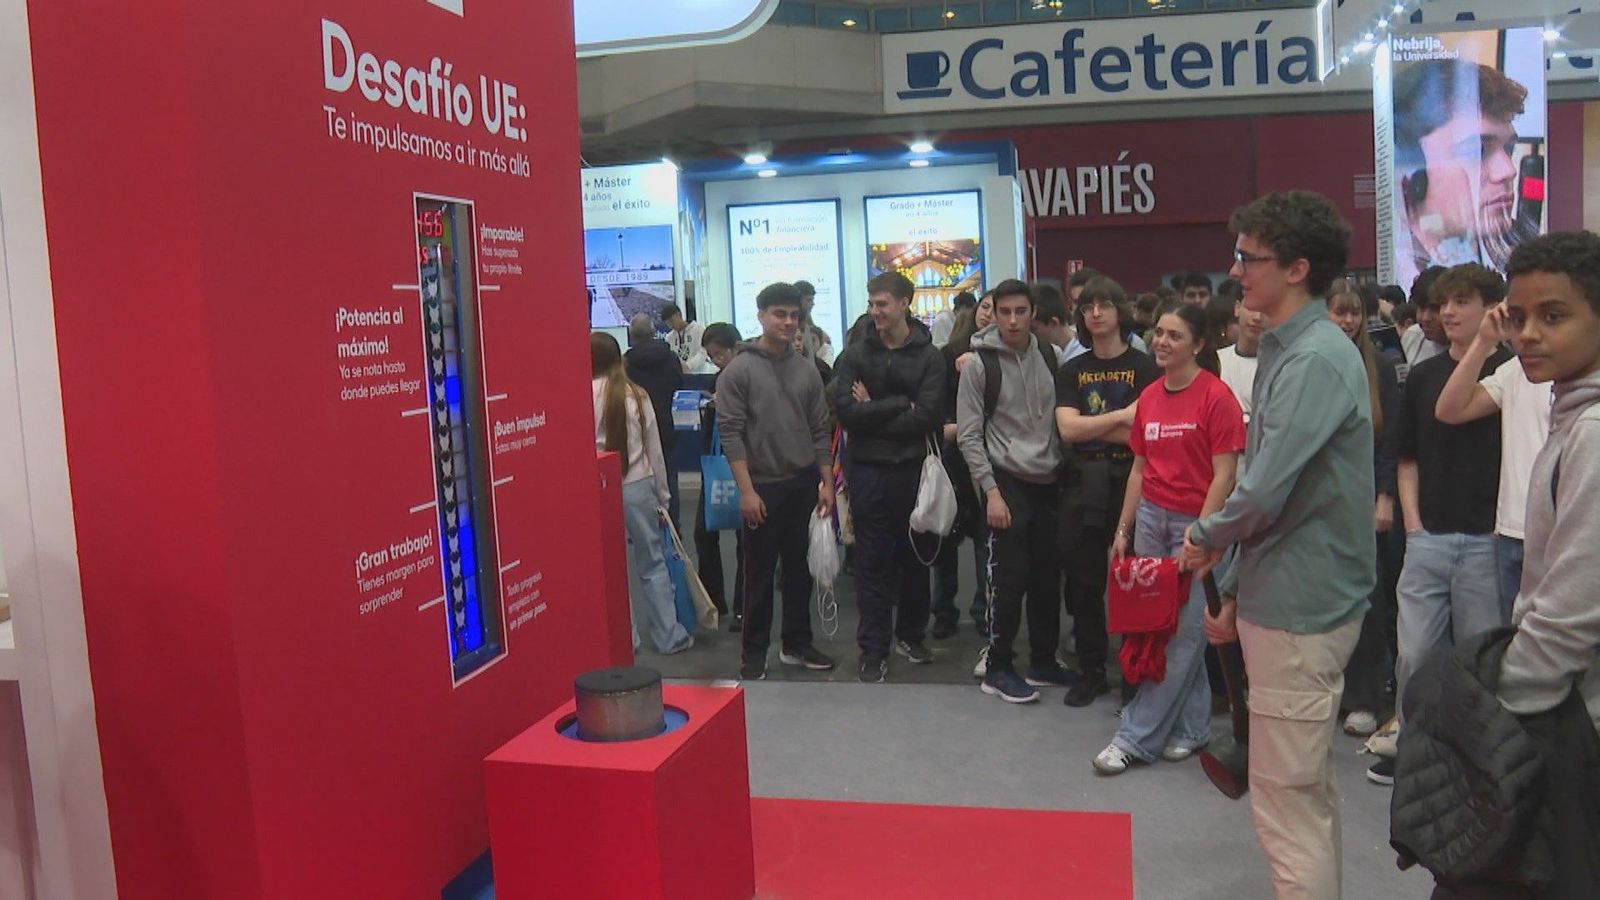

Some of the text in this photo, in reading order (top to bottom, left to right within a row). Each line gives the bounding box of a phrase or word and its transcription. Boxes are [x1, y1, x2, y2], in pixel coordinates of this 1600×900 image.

[1393, 36, 1444, 51] Nebrija,
[1393, 48, 1459, 61] la Universidad
[959, 20, 1323, 100] Cafetería
[321, 18, 528, 143] Desafío UE:
[323, 105, 530, 178] Te impulsamos a ir más allá
[594, 177, 631, 188] Máster
[591, 192, 612, 201] años
[612, 200, 621, 210] el
[624, 199, 650, 209] éxito
[890, 201, 915, 210] Grado
[924, 199, 953, 209] Máster
[481, 222, 524, 243] ¡Imparable!
[336, 306, 403, 332] ¡Potencia al
[338, 335, 389, 357] máximo!
[339, 361, 405, 379] Ya se nota hasta
[341, 379, 420, 400] donde puedes llegar
[516, 410, 546, 433] impulso!
[711, 479, 737, 505] EF
[355, 528, 433, 579] ¡Gran trabajo!
[357, 555, 434, 593] Tienes margen para
[360, 587, 403, 614] sorprender
